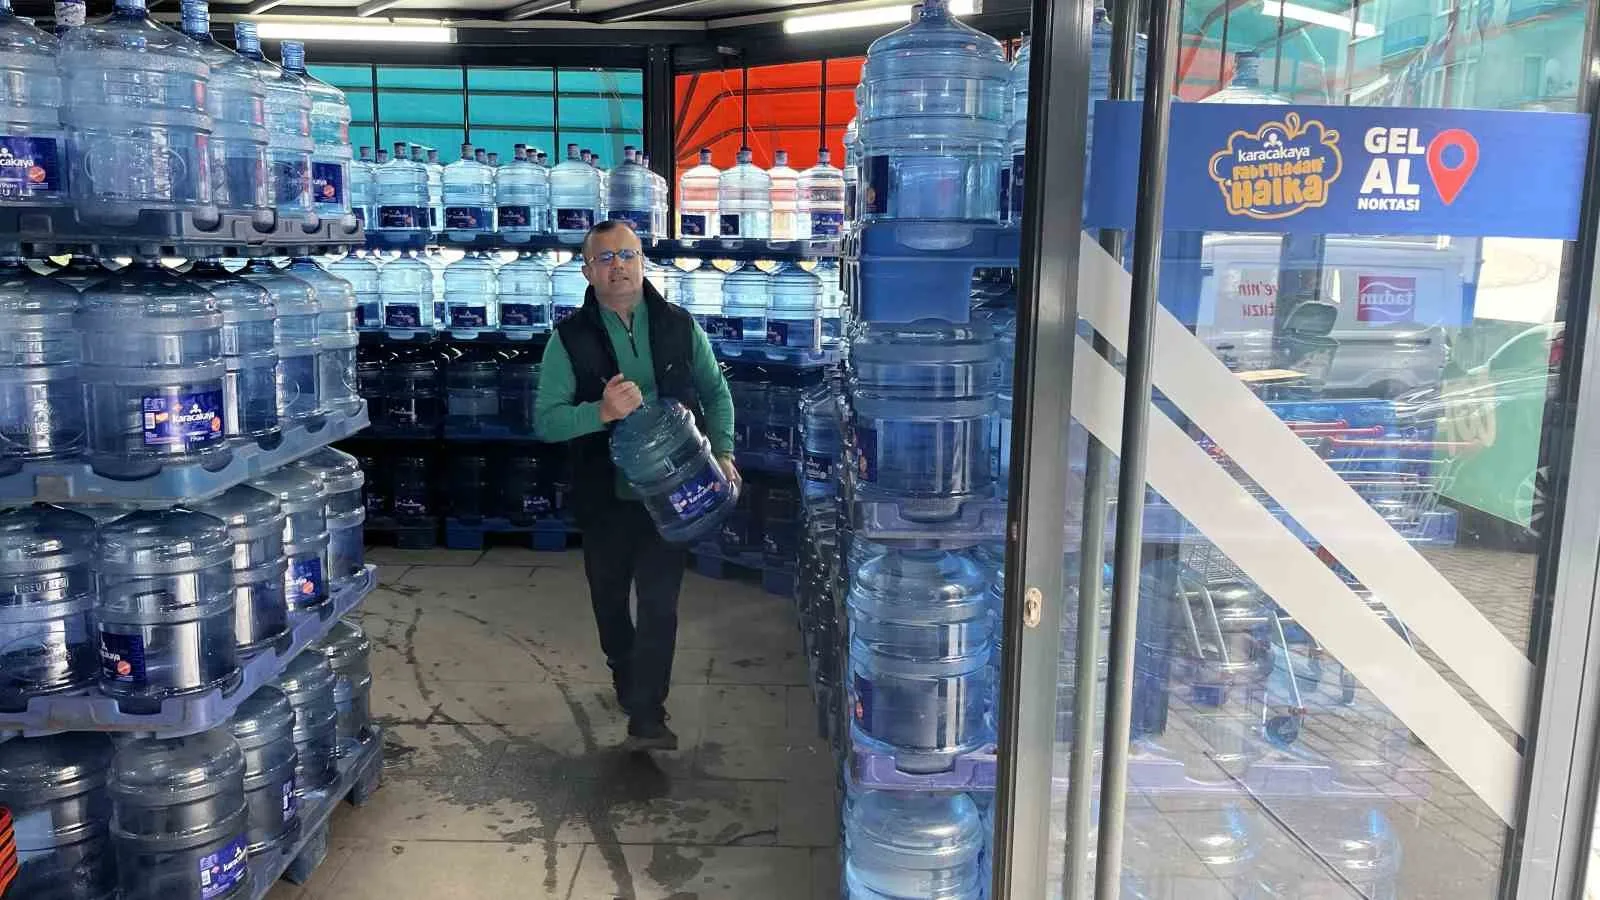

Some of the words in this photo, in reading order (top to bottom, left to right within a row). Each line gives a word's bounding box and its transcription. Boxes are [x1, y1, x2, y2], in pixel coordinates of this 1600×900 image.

[1364, 127, 1426, 154] GEL
[1238, 146, 1310, 162] karacakaya
[0, 158, 34, 168] cakaya
[1360, 158, 1420, 195] AL
[1357, 198, 1420, 211] NOKTASI
